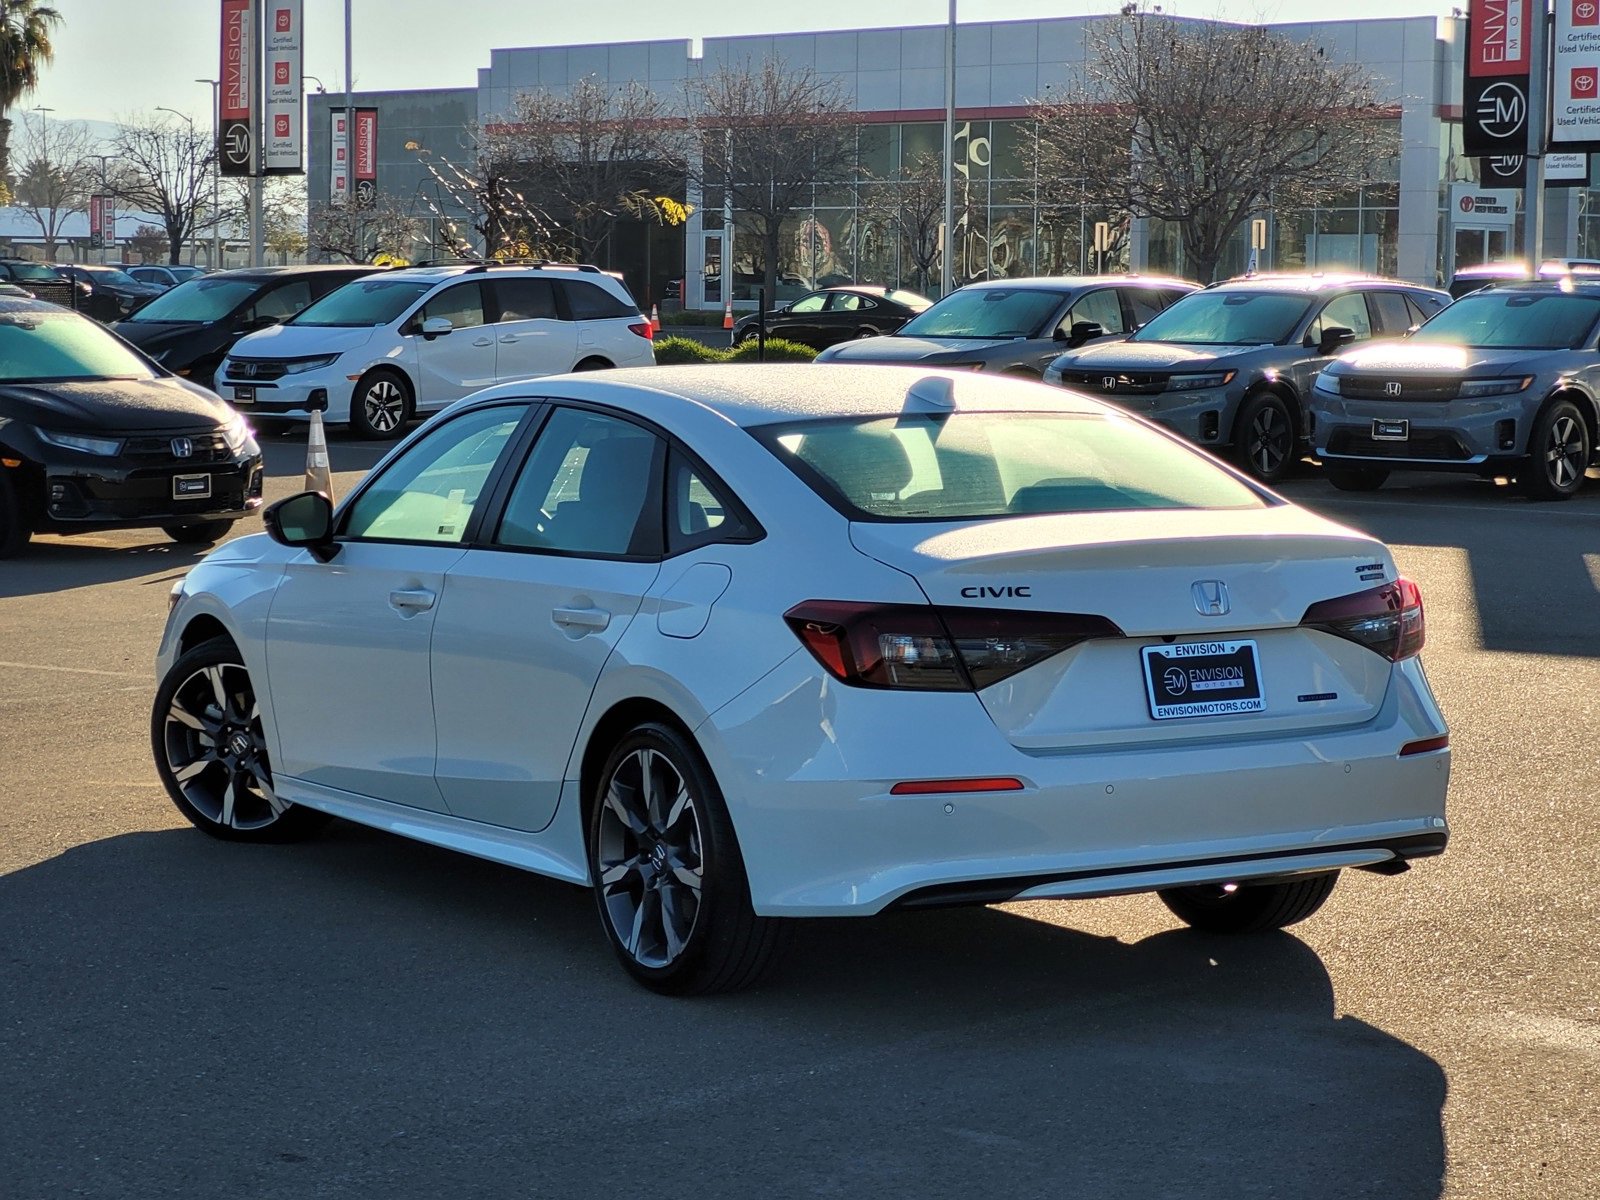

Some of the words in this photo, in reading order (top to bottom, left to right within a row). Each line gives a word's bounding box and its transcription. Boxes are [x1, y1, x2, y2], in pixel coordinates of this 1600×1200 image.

[1558, 44, 1577, 54] Used
[228, 10, 241, 110] ENVISION
[1557, 117, 1577, 126] Used
[359, 117, 368, 174] ENVISION
[1354, 563, 1385, 573] SPORT
[960, 586, 1032, 598] CIVIC
[1175, 643, 1226, 656] ENVISION
[1189, 666, 1244, 682] ENVISION
[1195, 680, 1240, 689] MOTORS
[1157, 700, 1262, 717] ENVISIONMOTORS.COM
